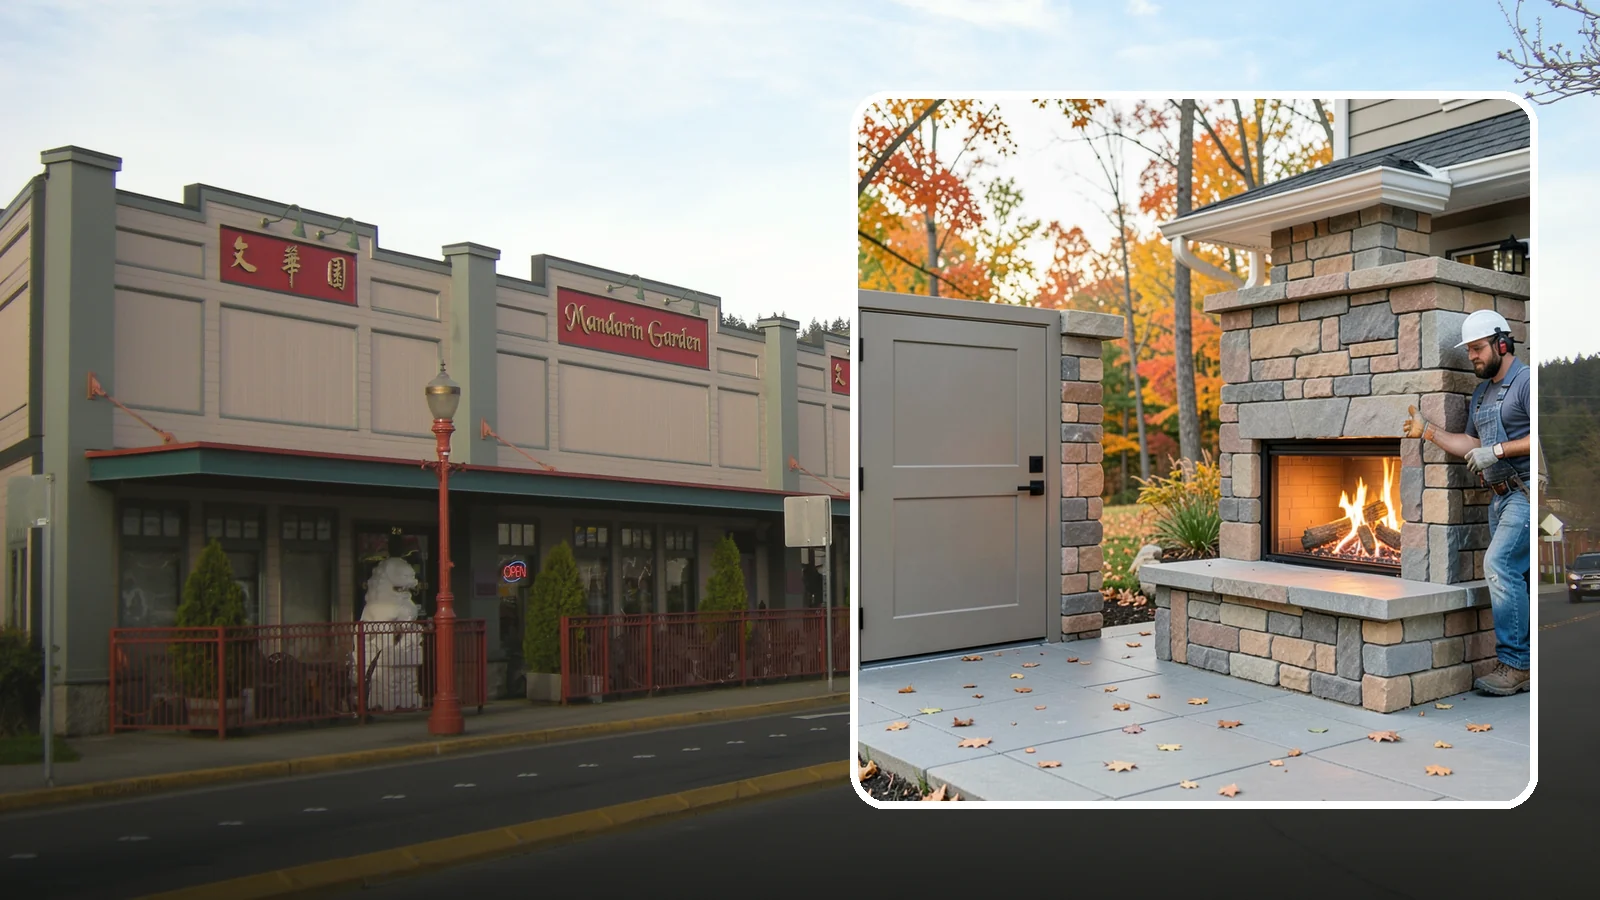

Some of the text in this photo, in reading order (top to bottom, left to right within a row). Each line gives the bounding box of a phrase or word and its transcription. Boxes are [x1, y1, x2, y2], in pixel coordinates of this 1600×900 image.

[231, 235, 346, 291] 文華園
[564, 302, 701, 352] Mandarin Garden
[503, 565, 527, 578] OPEN
